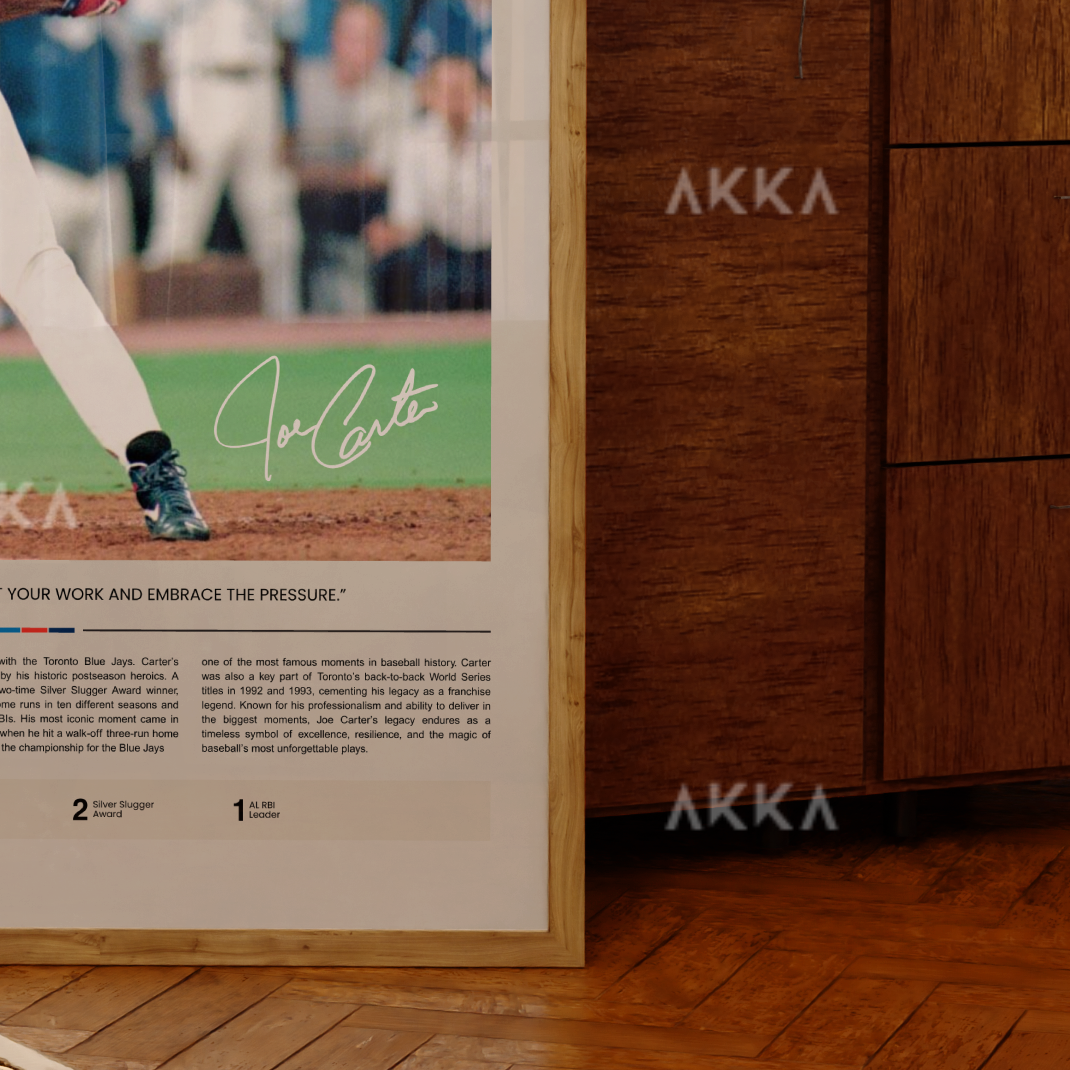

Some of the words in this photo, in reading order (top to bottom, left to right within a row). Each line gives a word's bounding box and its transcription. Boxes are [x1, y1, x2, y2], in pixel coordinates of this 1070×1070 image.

[214, 355, 318, 481] Joe
[311, 364, 439, 469] Carter
[7, 587, 50, 601] YOUR
[55, 587, 104, 601] WORK
[109, 588, 143, 601] AND
[148, 588, 222, 601] EMBRACE
[227, 588, 255, 601] THE
[260, 588, 346, 602] PRESSURE.”
[223, 657, 233, 666] of
[237, 657, 252, 667] the
[256, 658, 279, 667] most
[282, 657, 317, 667] famous
[321, 658, 365, 667] moments
[368, 657, 377, 667] in
[381, 658, 420, 667] baseball
[424, 658, 457, 669] history.
[461, 658, 491, 667] Carter
[0, 671, 12, 682] by
[16, 671, 30, 680] his
[34, 671, 68, 680] historic
[72, 672, 126, 682] postseason
[130, 671, 167, 681] heroics.
[171, 671, 179, 681] A
[73, 798, 88, 821] 2
[92, 800, 117, 808] Silver
[119, 800, 154, 811] Slugger
[233, 799, 243, 821] 1
[249, 801, 259, 809] AL
[261, 801, 275, 809] RBI
[92, 810, 123, 819] Award
[249, 811, 280, 819] Leader
